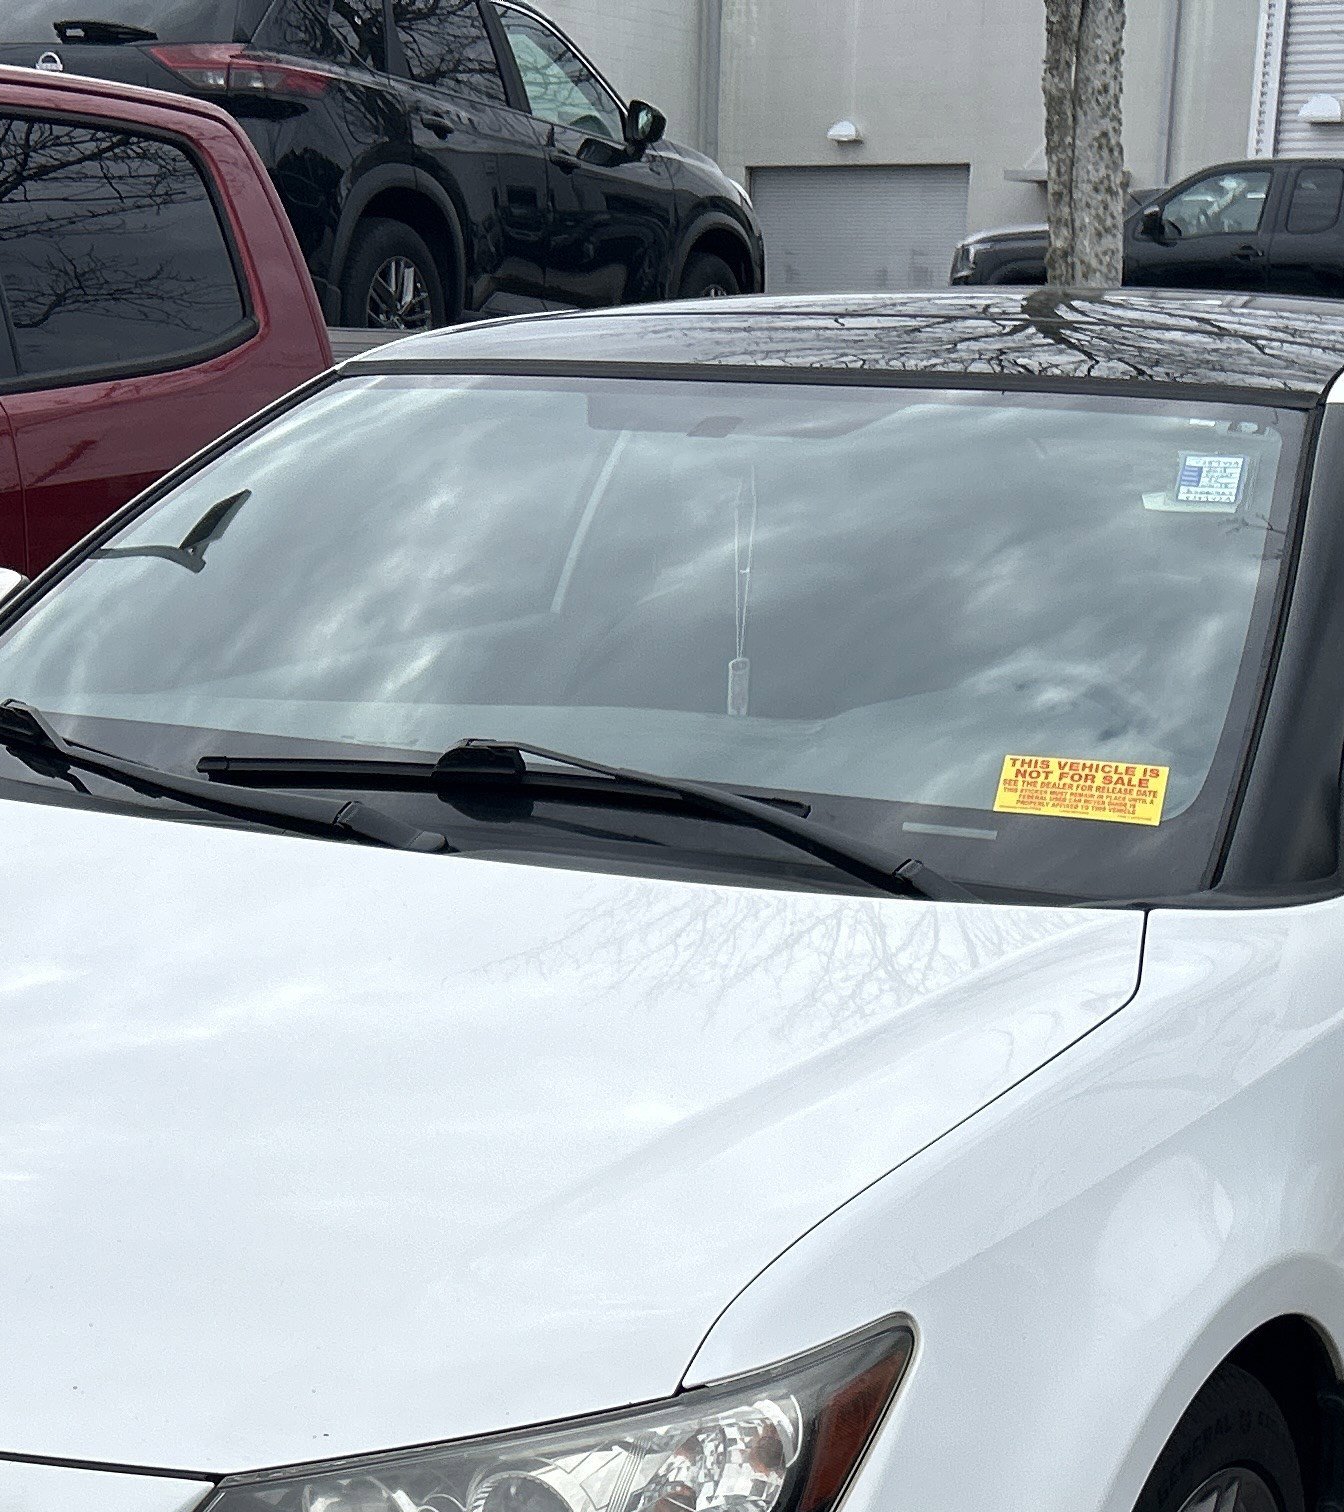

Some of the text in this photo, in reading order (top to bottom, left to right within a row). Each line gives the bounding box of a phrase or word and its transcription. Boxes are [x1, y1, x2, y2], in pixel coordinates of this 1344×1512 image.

[1010, 758, 1160, 778] THIS VEHICLE IS
[1015, 769, 1149, 788] NOT FOR SALE
[1022, 780, 1038, 788] THE
[1040, 782, 1073, 790] DEALER
[1096, 786, 1134, 795] RELEASE
[1136, 790, 1157, 798] DATE
